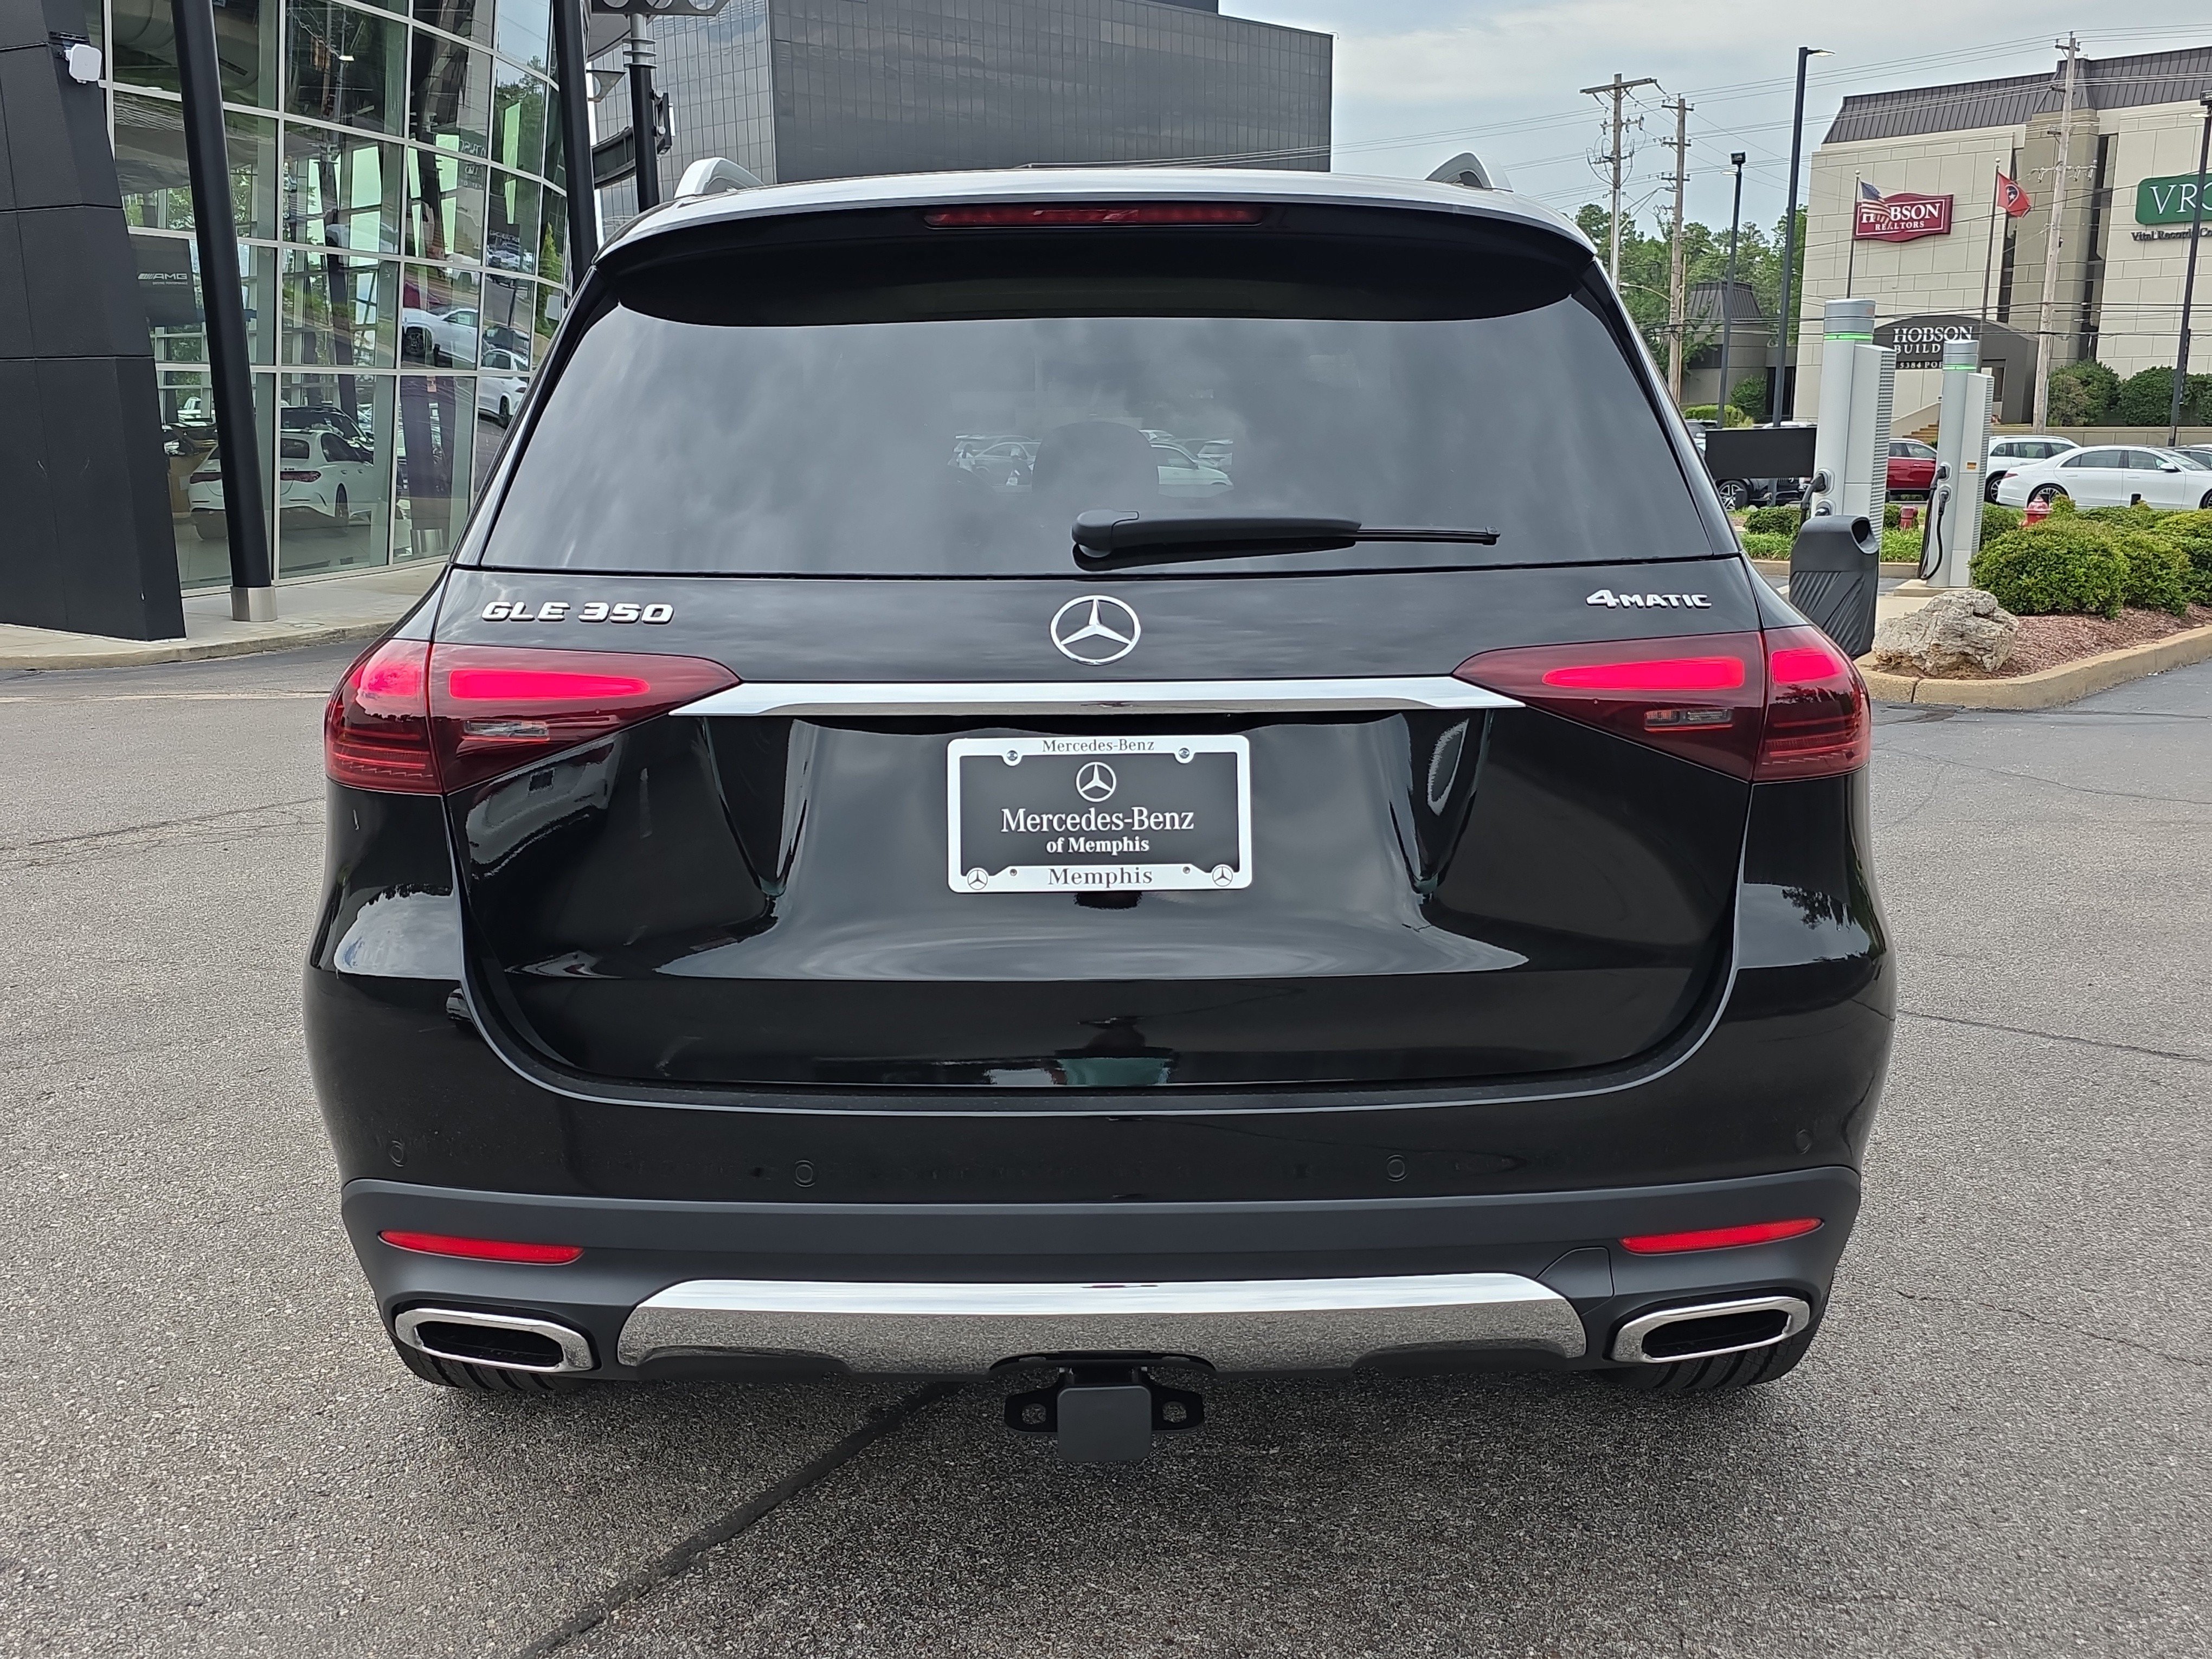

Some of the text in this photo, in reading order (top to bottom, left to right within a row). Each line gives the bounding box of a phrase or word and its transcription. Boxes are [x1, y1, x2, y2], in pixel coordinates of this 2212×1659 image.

[1861, 203, 1941, 223] HBSON
[2131, 230, 2156, 241] Vital
[2157, 228, 2192, 240] Record
[1893, 326, 1973, 343] HOBSON
[1894, 343, 1941, 354] BUILD
[1899, 361, 1921, 369] 5384
[1586, 589, 1712, 609] 4MATIC
[481, 601, 674, 625] GLE 350
[1042, 739, 1155, 753] Mercedes-Benz
[1000, 806, 1194, 833] Mercedes-Benz
[1046, 836, 1150, 856] of Memphis
[1048, 866, 1153, 888] Memphis
